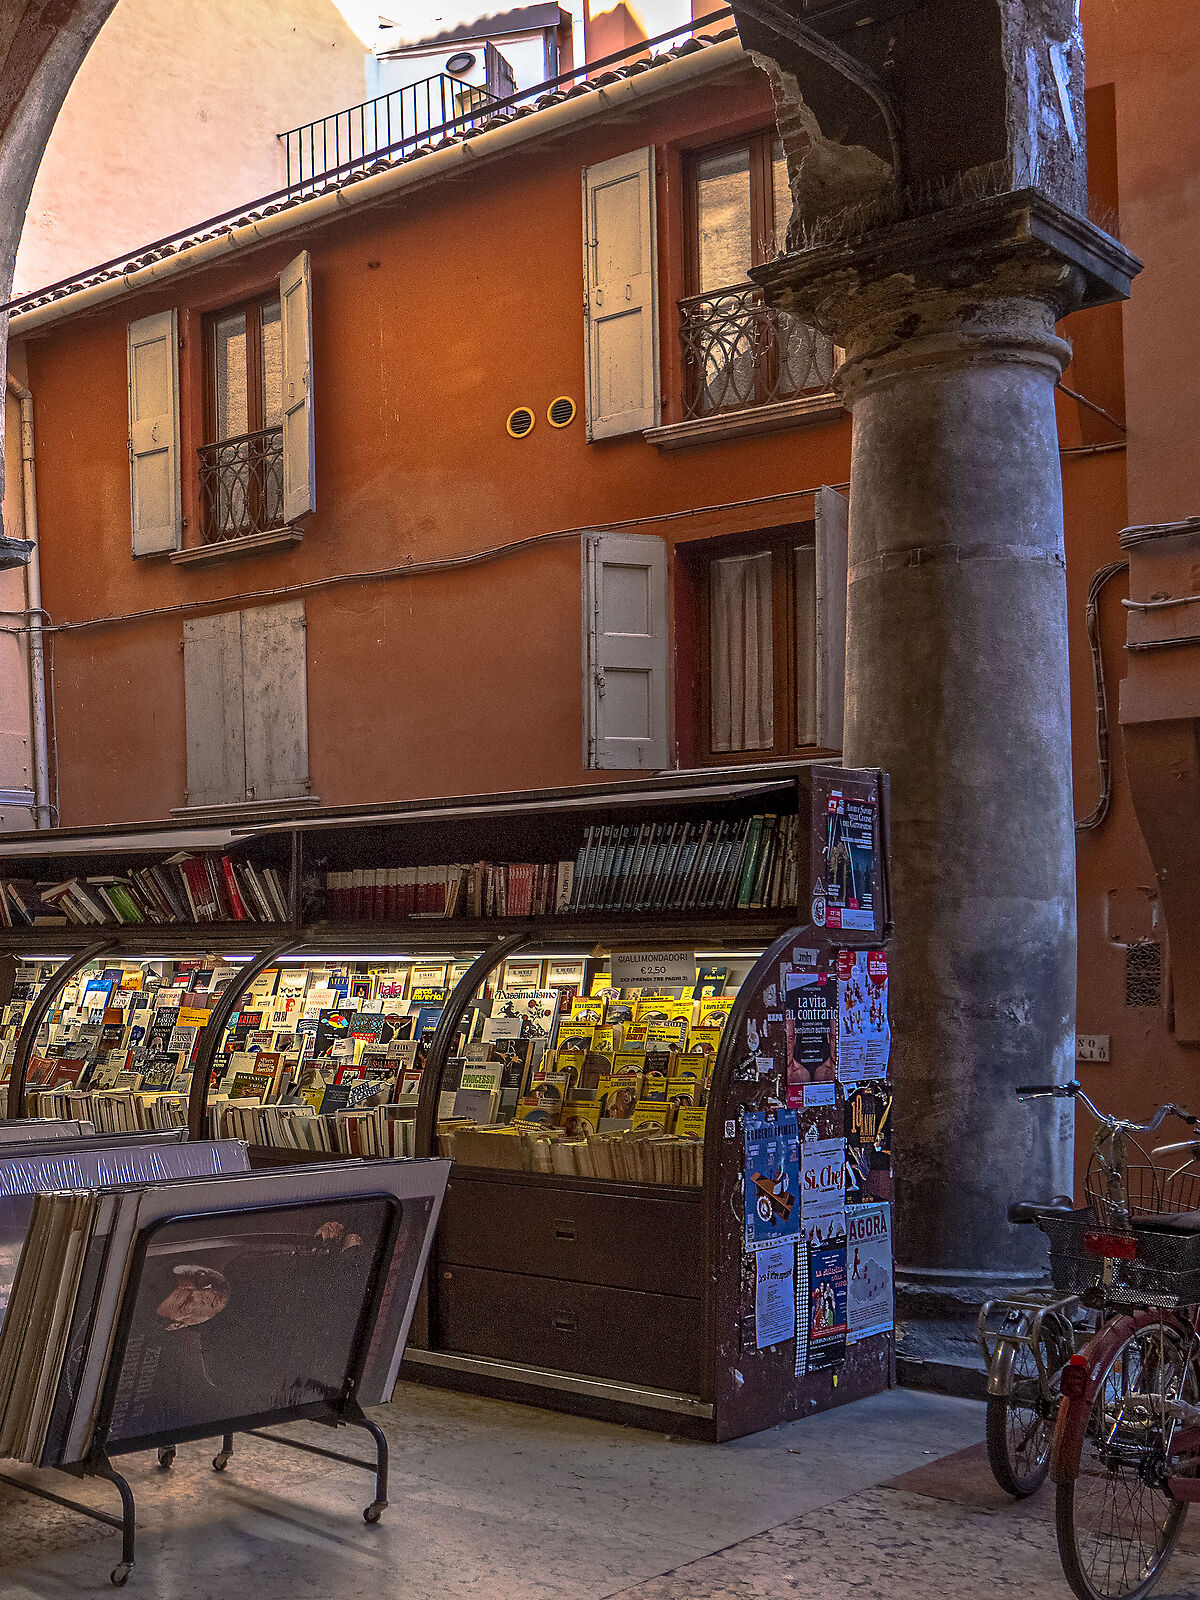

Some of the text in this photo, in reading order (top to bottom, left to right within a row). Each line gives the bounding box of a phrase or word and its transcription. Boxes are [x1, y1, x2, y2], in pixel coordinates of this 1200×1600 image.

[618, 953, 688, 963] GIALLI MONDADORI
[379, 981, 402, 995] Italia
[495, 989, 557, 1000] Massimalismo
[811, 995, 826, 1007] vita
[463, 1074, 495, 1084] PROCESSO
[820, 1164, 846, 1190] Chef
[849, 1209, 888, 1241] AGORÀ
